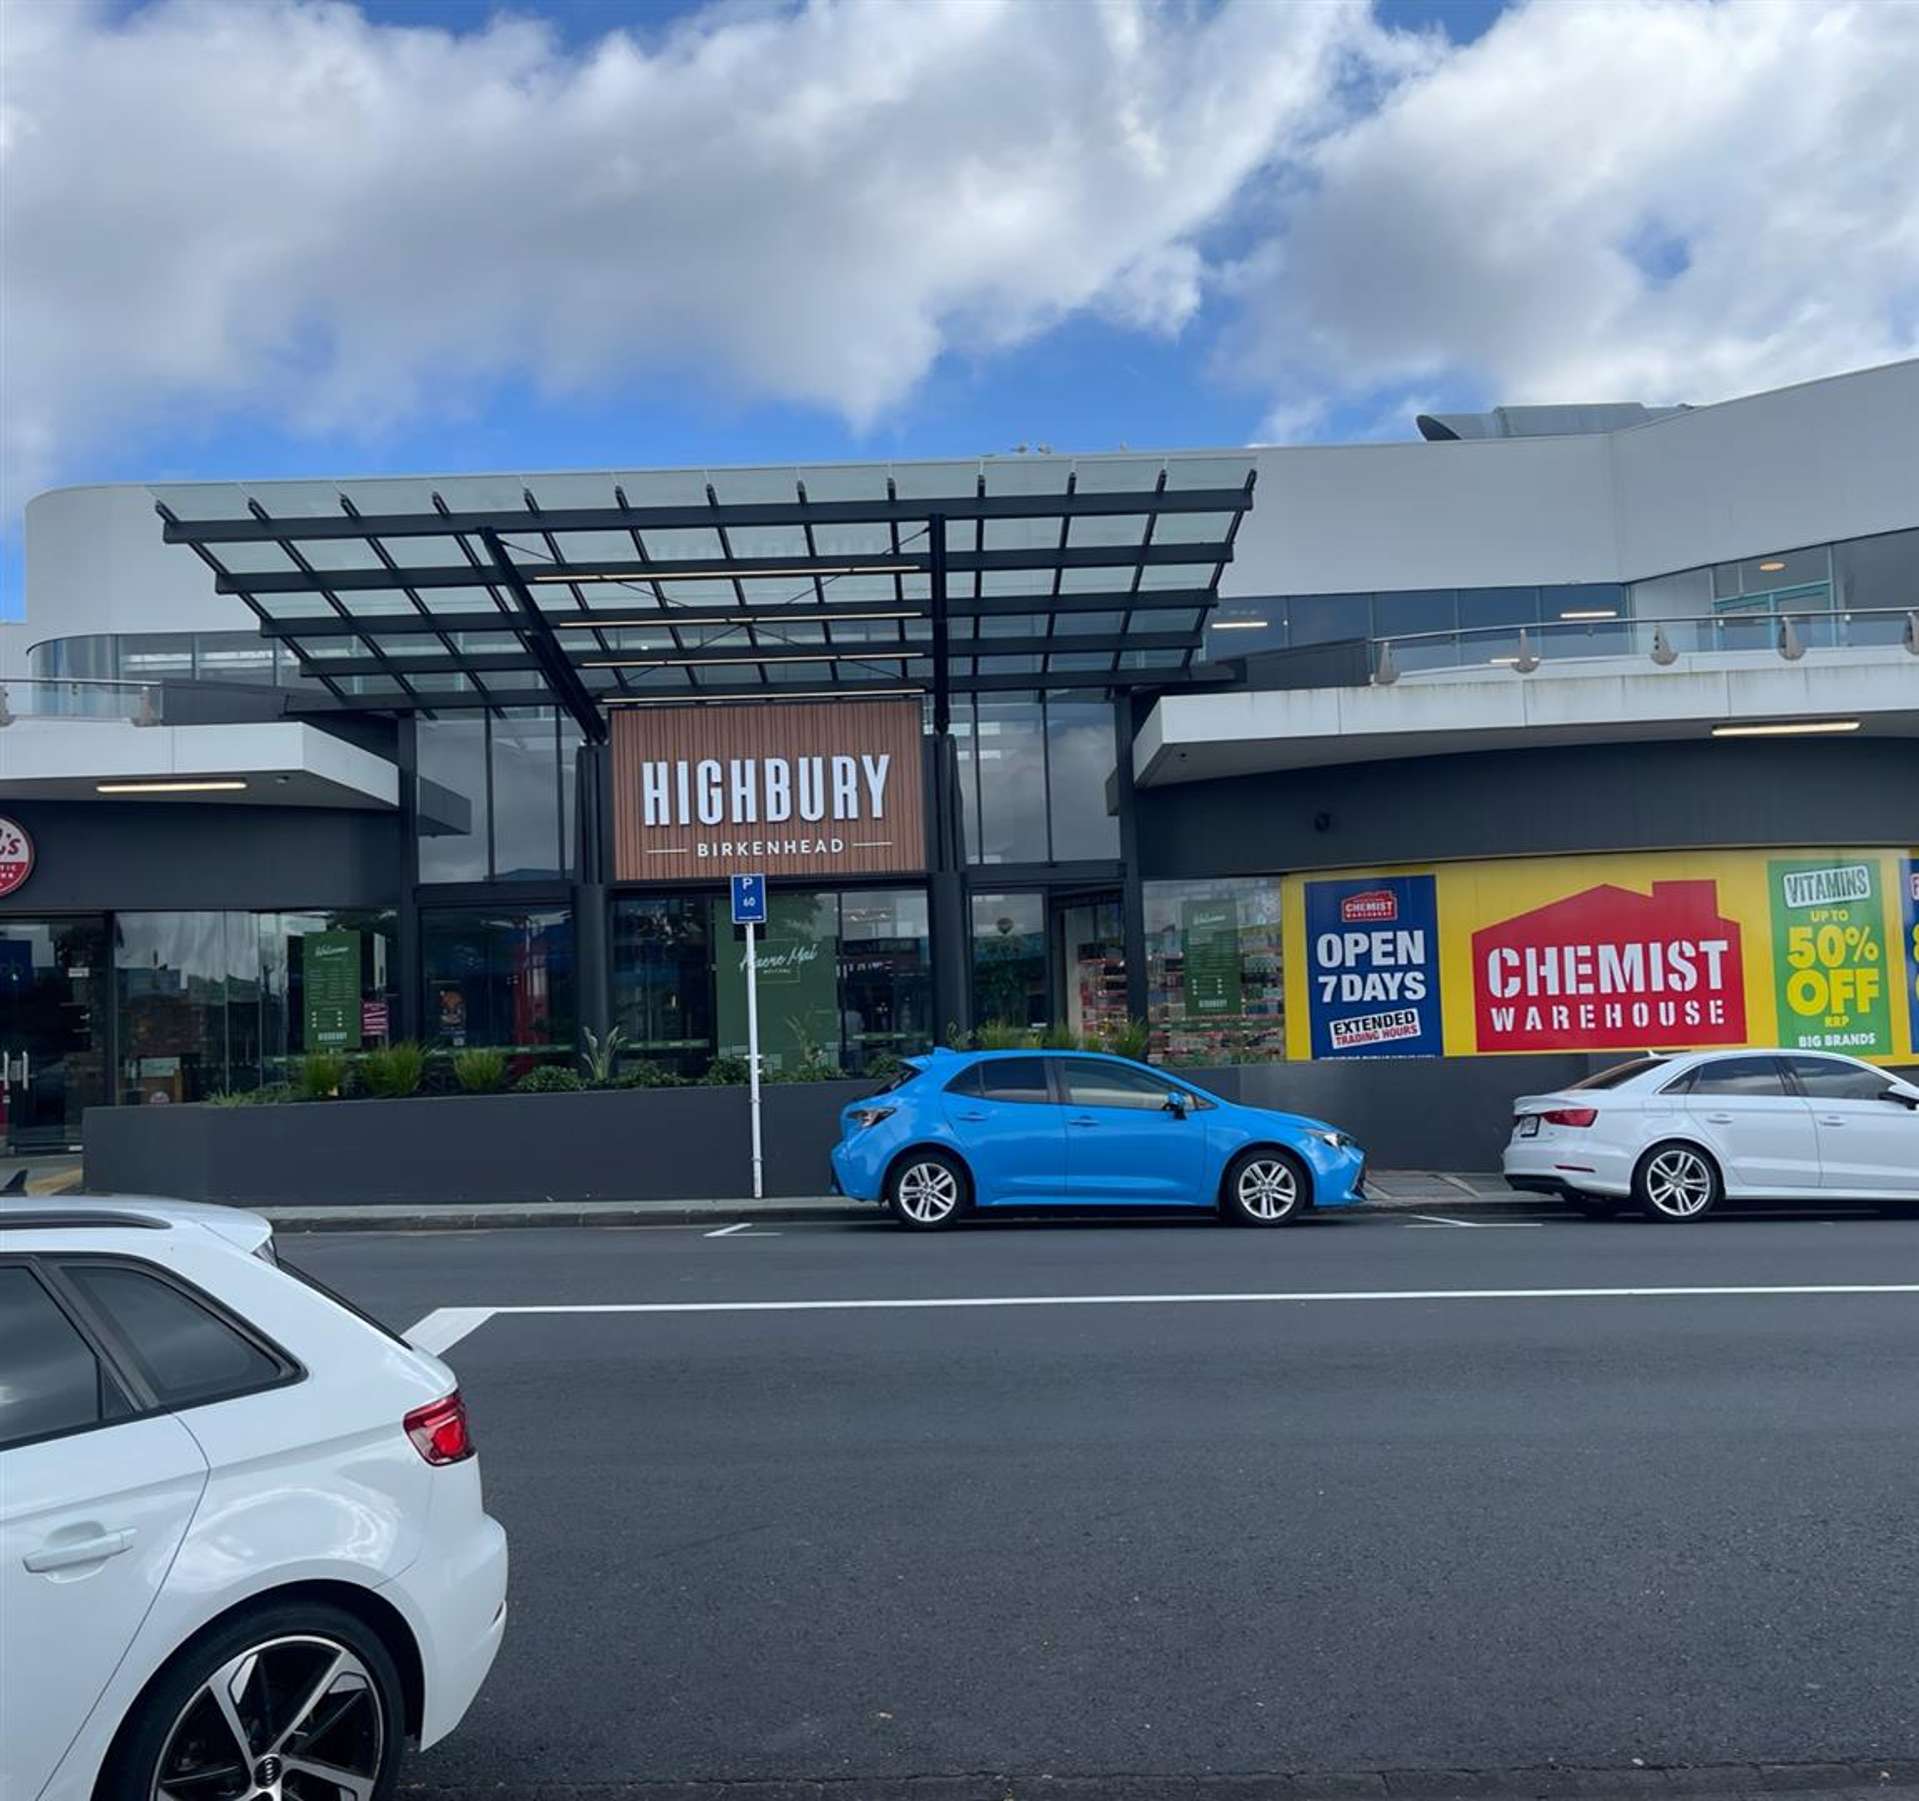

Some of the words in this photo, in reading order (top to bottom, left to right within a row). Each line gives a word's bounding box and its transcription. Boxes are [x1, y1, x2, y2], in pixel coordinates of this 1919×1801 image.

[642, 754, 890, 826] HIGHBURY
[698, 838, 844, 857] BIRKENHEAD
[743, 878, 753, 890] P
[1786, 868, 1868, 904] VITAMINS
[1345, 900, 1393, 913] CHEMIST
[1810, 911, 1826, 922] UP
[1830, 909, 1849, 922] TO
[1316, 930, 1426, 968] OPEN
[1787, 924, 1880, 969] 50%
[1488, 940, 1728, 998] CHEMIST
[1318, 975, 1338, 1003] 7
[1342, 971, 1427, 1002] DAYS
[1786, 968, 1880, 1016] OFF
[1334, 1010, 1415, 1036] EXTENDED
[1491, 1000, 1725, 1032] WAREHOUSE
[1336, 1031, 1379, 1046] TRADING
[1382, 1024, 1418, 1039] HOURS
[1798, 1035, 1821, 1048] BIG
[1824, 1032, 1876, 1046] BRANDS
